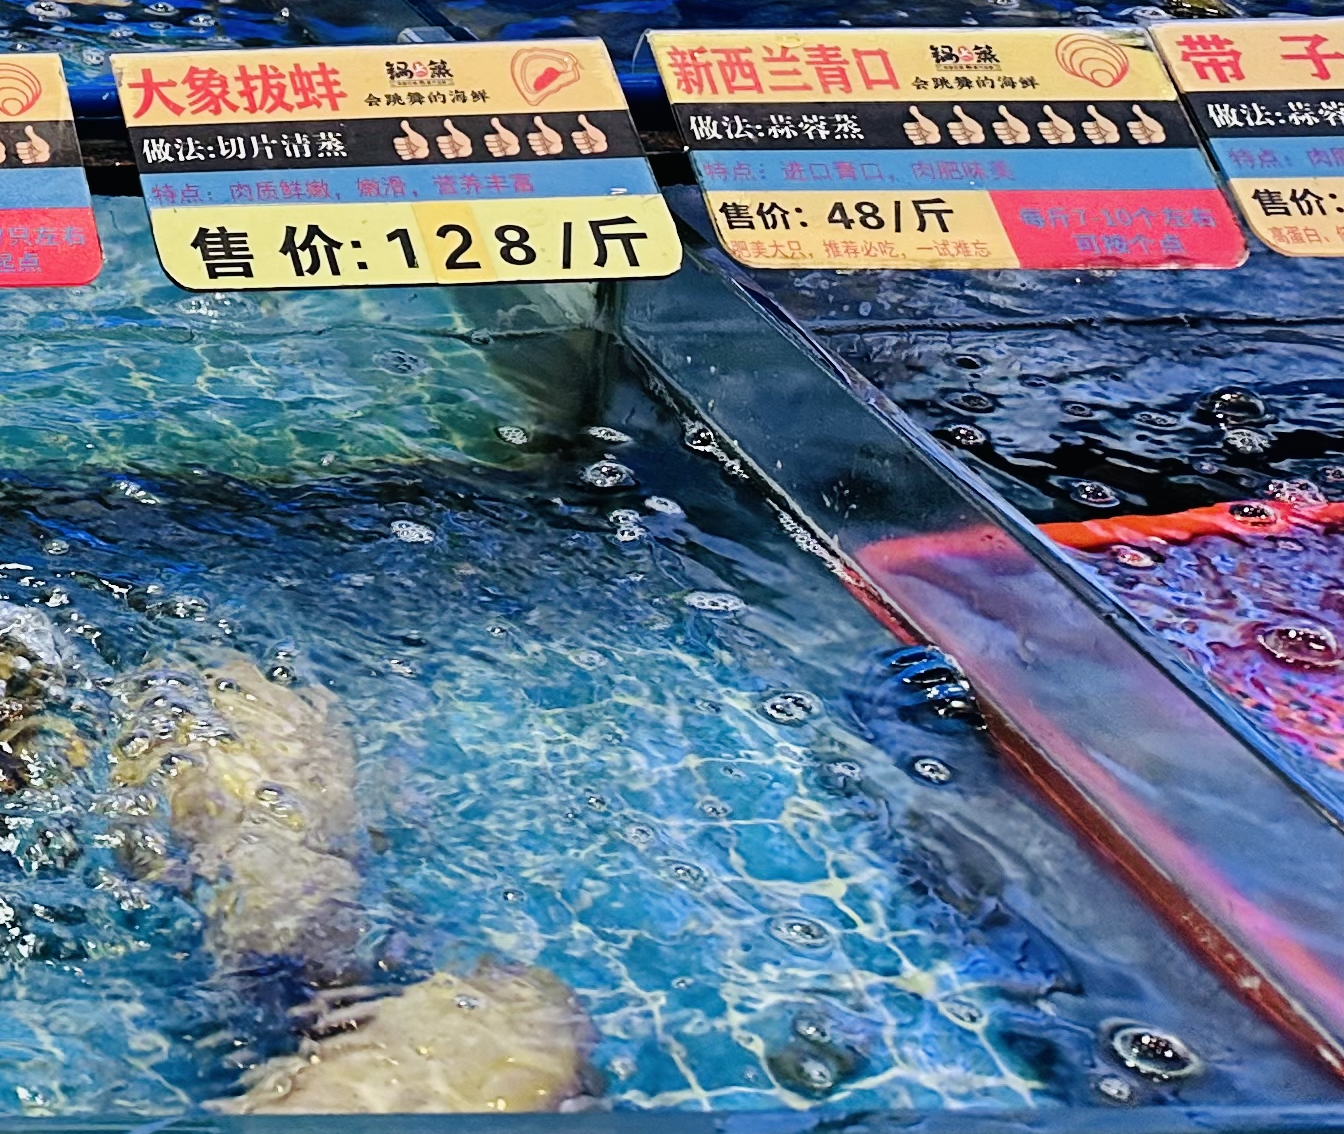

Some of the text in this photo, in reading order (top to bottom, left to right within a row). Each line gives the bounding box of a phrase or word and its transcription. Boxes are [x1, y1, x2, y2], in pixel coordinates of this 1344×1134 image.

[667, 46, 900, 96] 新西兰青口
[1175, 34, 1344, 83] 带子
[128, 62, 348, 119] 大象拔蚌
[364, 89, 490, 107] 会跳舞的海鲜
[911, 76, 1041, 90] 会跳舞的海鲜
[689, 113, 866, 141] 做法:蒜蓉蒸
[142, 131, 349, 165] 做法:切片清蒸
[1020, 207, 1217, 228] 每斤7-10个左右
[190, 216, 649, 280] 售价:128/斤
[1072, 234, 1185, 255] 可按个点
